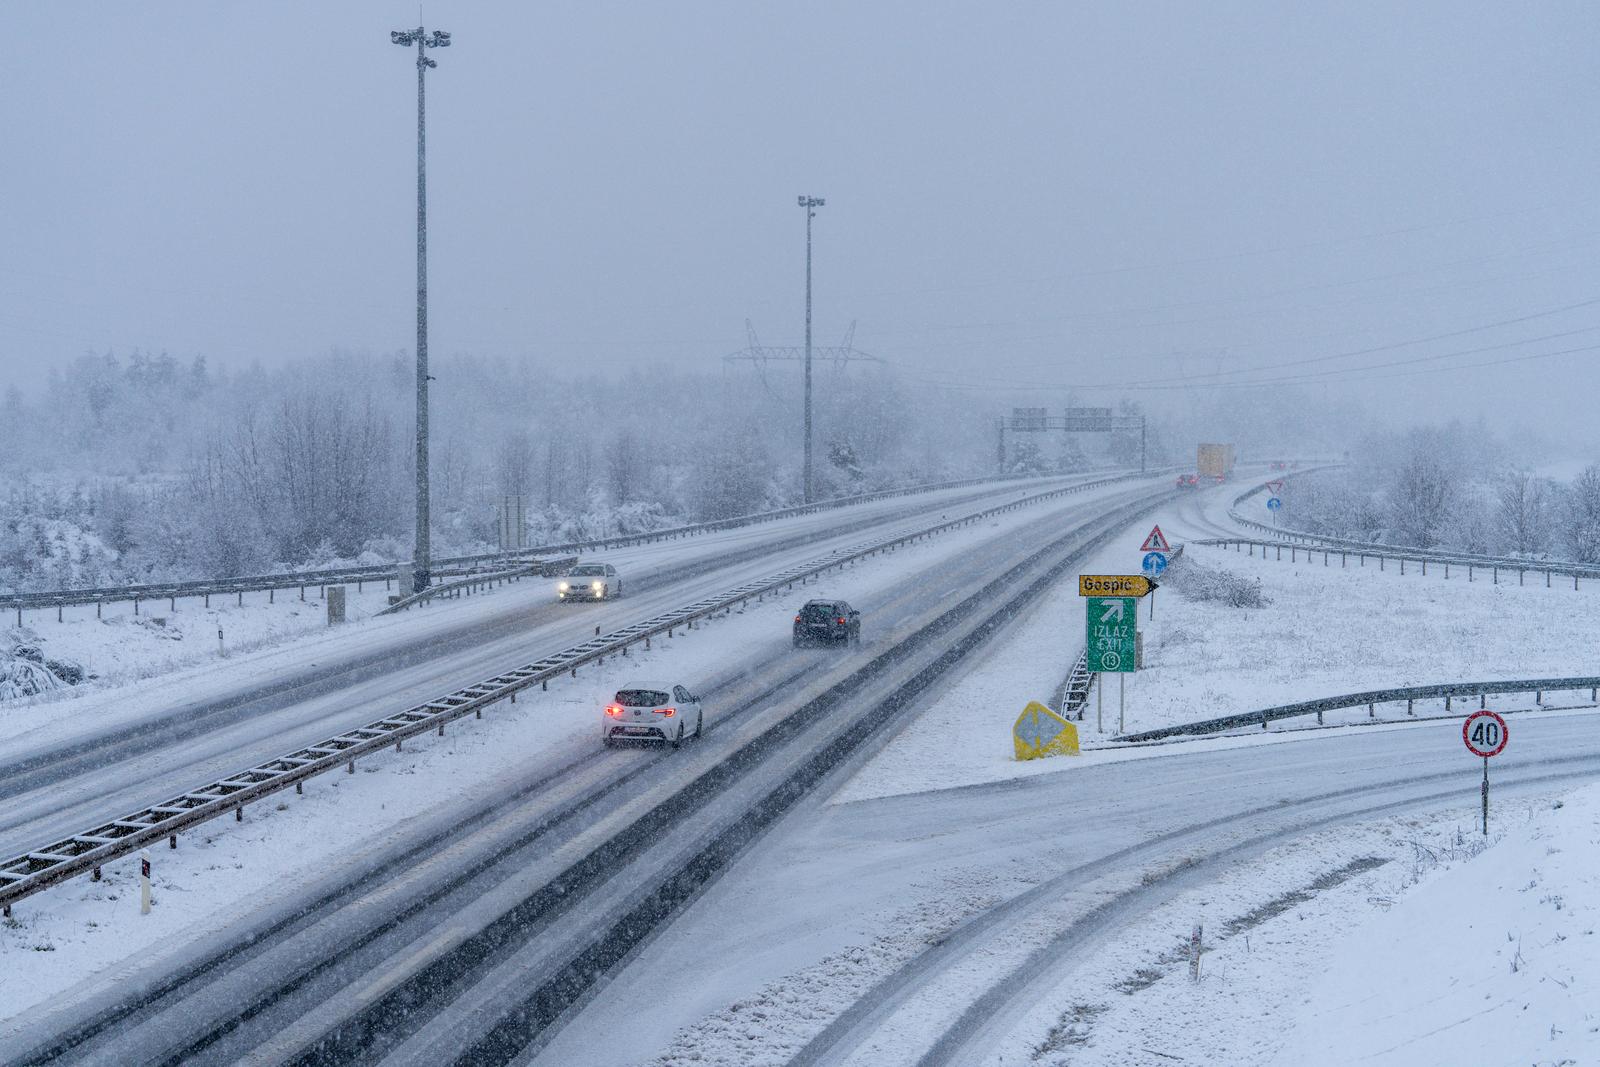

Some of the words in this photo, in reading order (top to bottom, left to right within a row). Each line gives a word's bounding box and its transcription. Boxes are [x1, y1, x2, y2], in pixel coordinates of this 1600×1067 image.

[1084, 577, 1132, 594] Gospić
[1094, 625, 1128, 638] IZLAZ
[1099, 638, 1122, 651] EXIT
[1106, 655, 1116, 666] 13
[1471, 722, 1498, 746] 40
